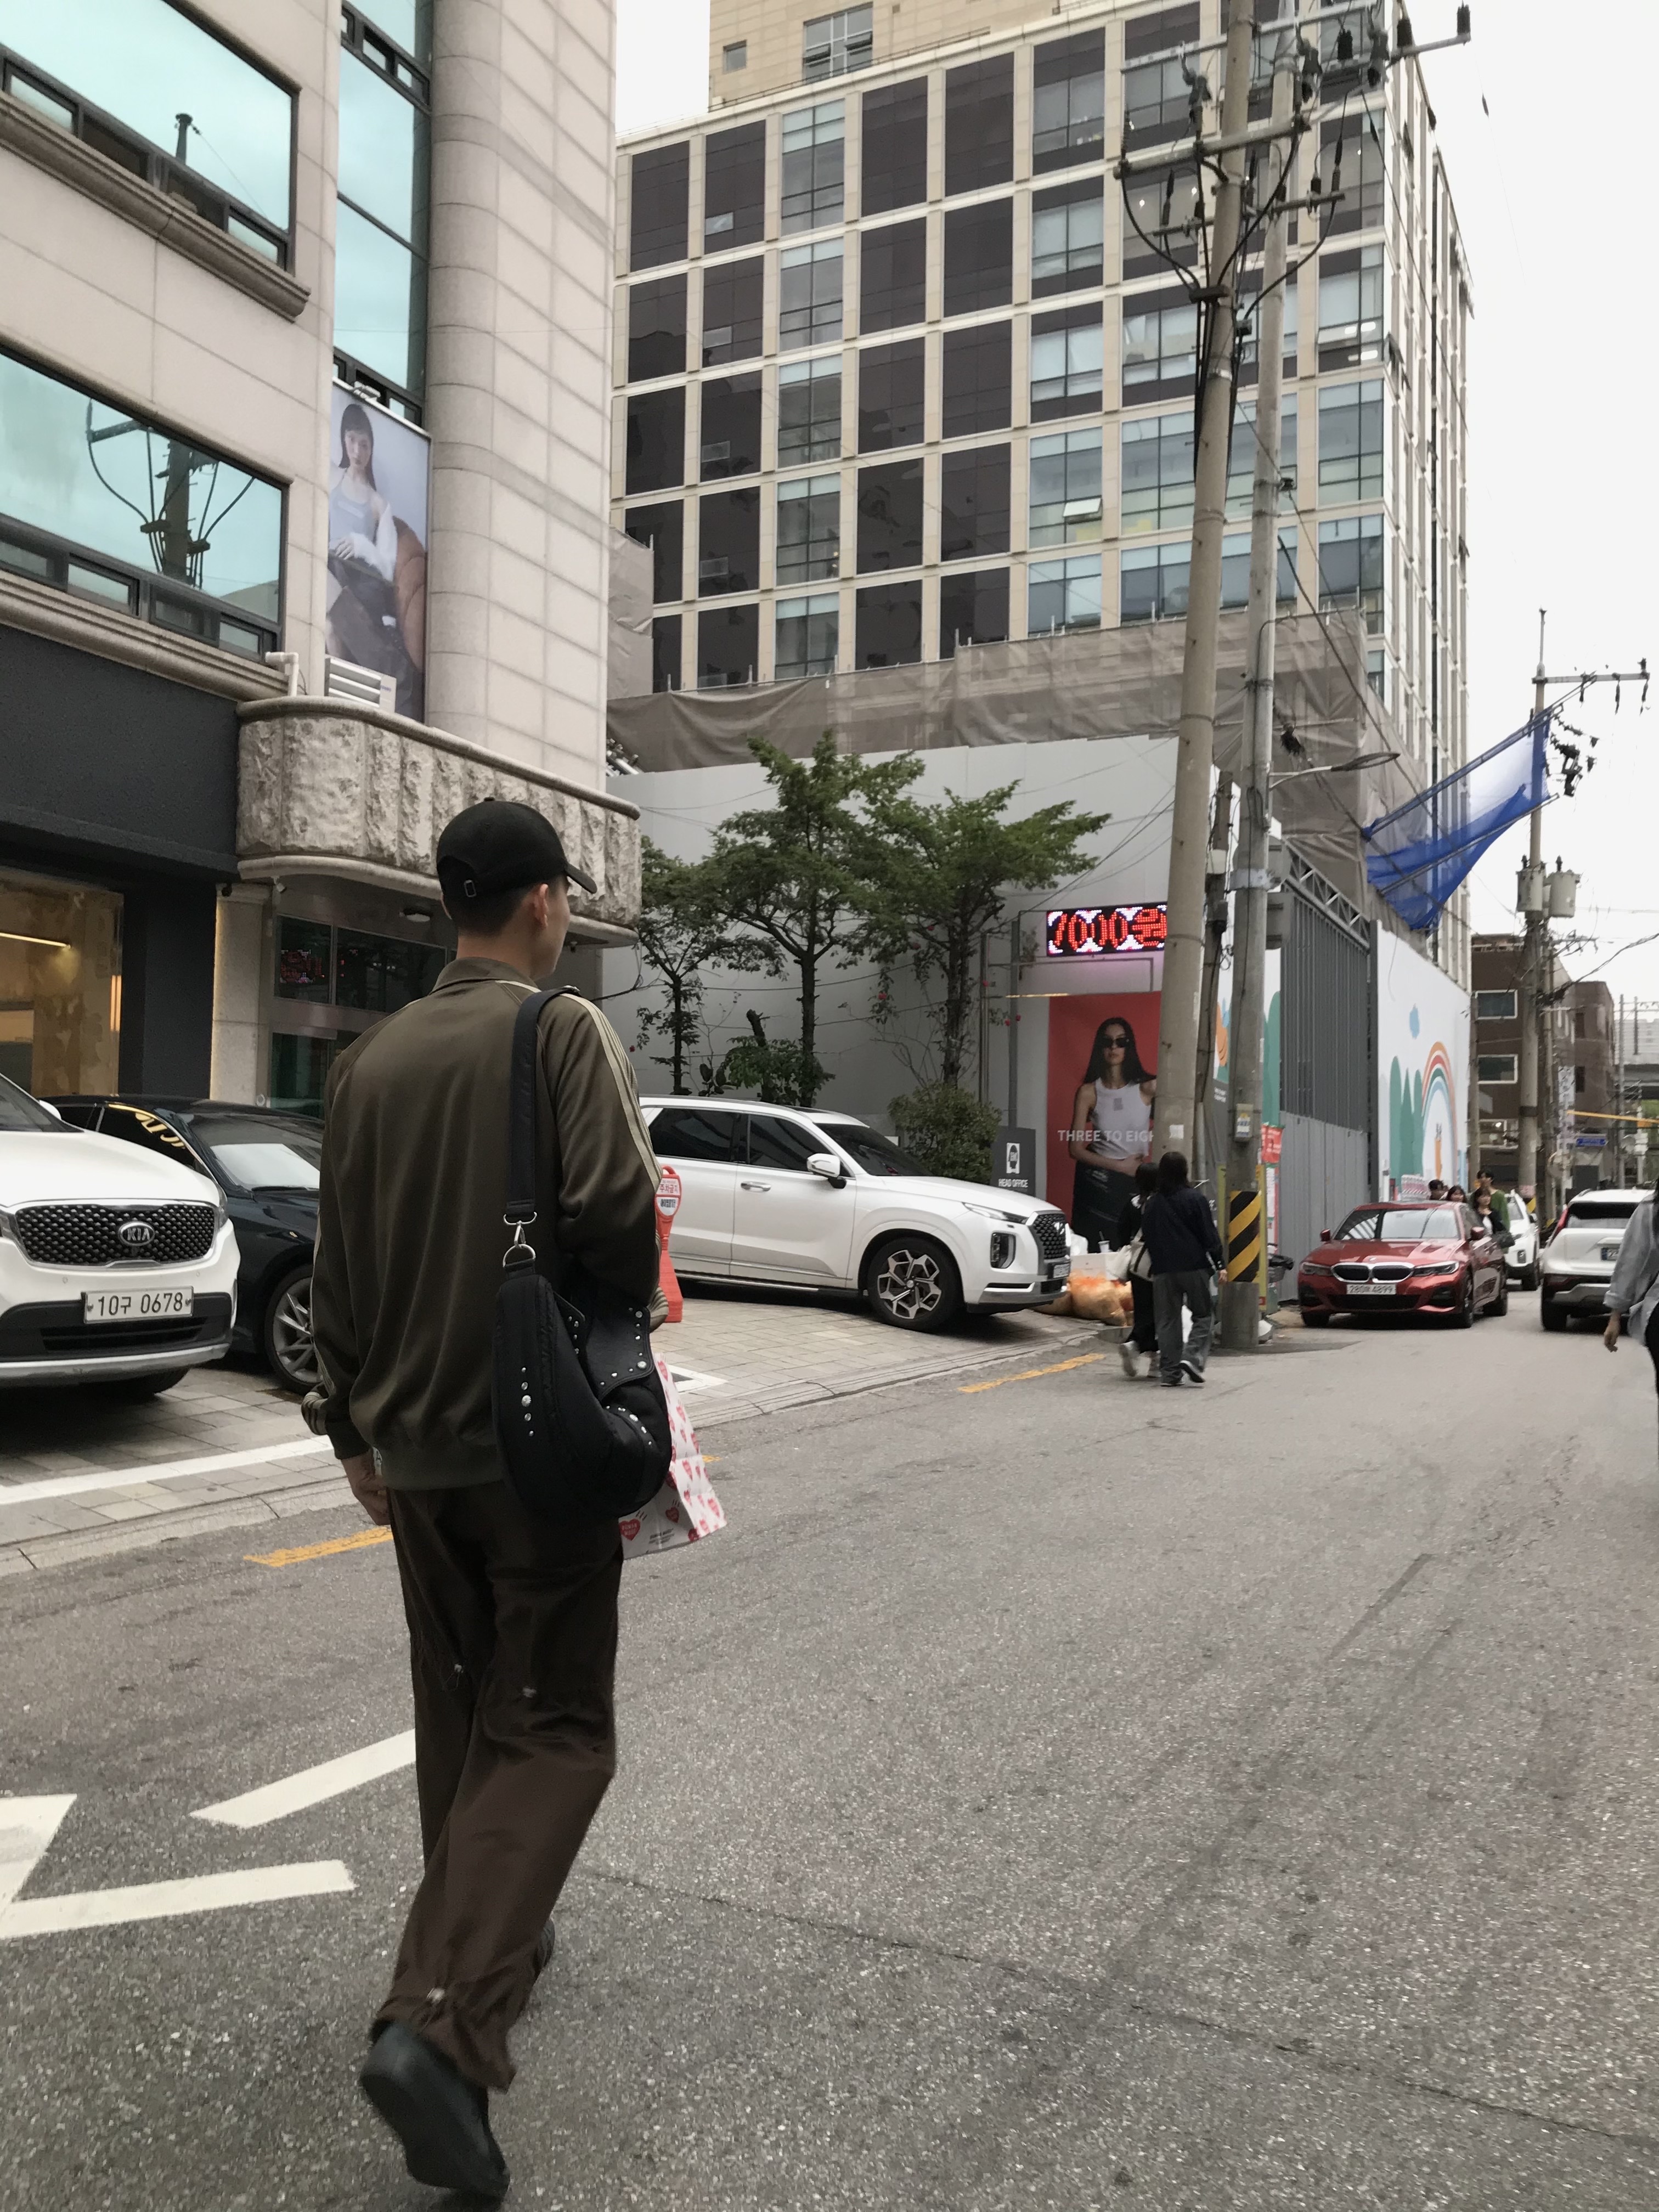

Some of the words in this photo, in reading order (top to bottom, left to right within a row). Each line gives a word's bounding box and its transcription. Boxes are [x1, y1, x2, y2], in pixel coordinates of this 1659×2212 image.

[1058, 1130, 1101, 1142] THREE
[1104, 1130, 1123, 1142] TO
[659, 1183, 678, 1193] 주차금지
[998, 1178, 1012, 1187] HEAD
[1012, 1178, 1029, 1188] OFFICE
[127, 1228, 150, 1241] KIA
[98, 1295, 132, 1317] 10구
[140, 1292, 183, 1314] 0678
